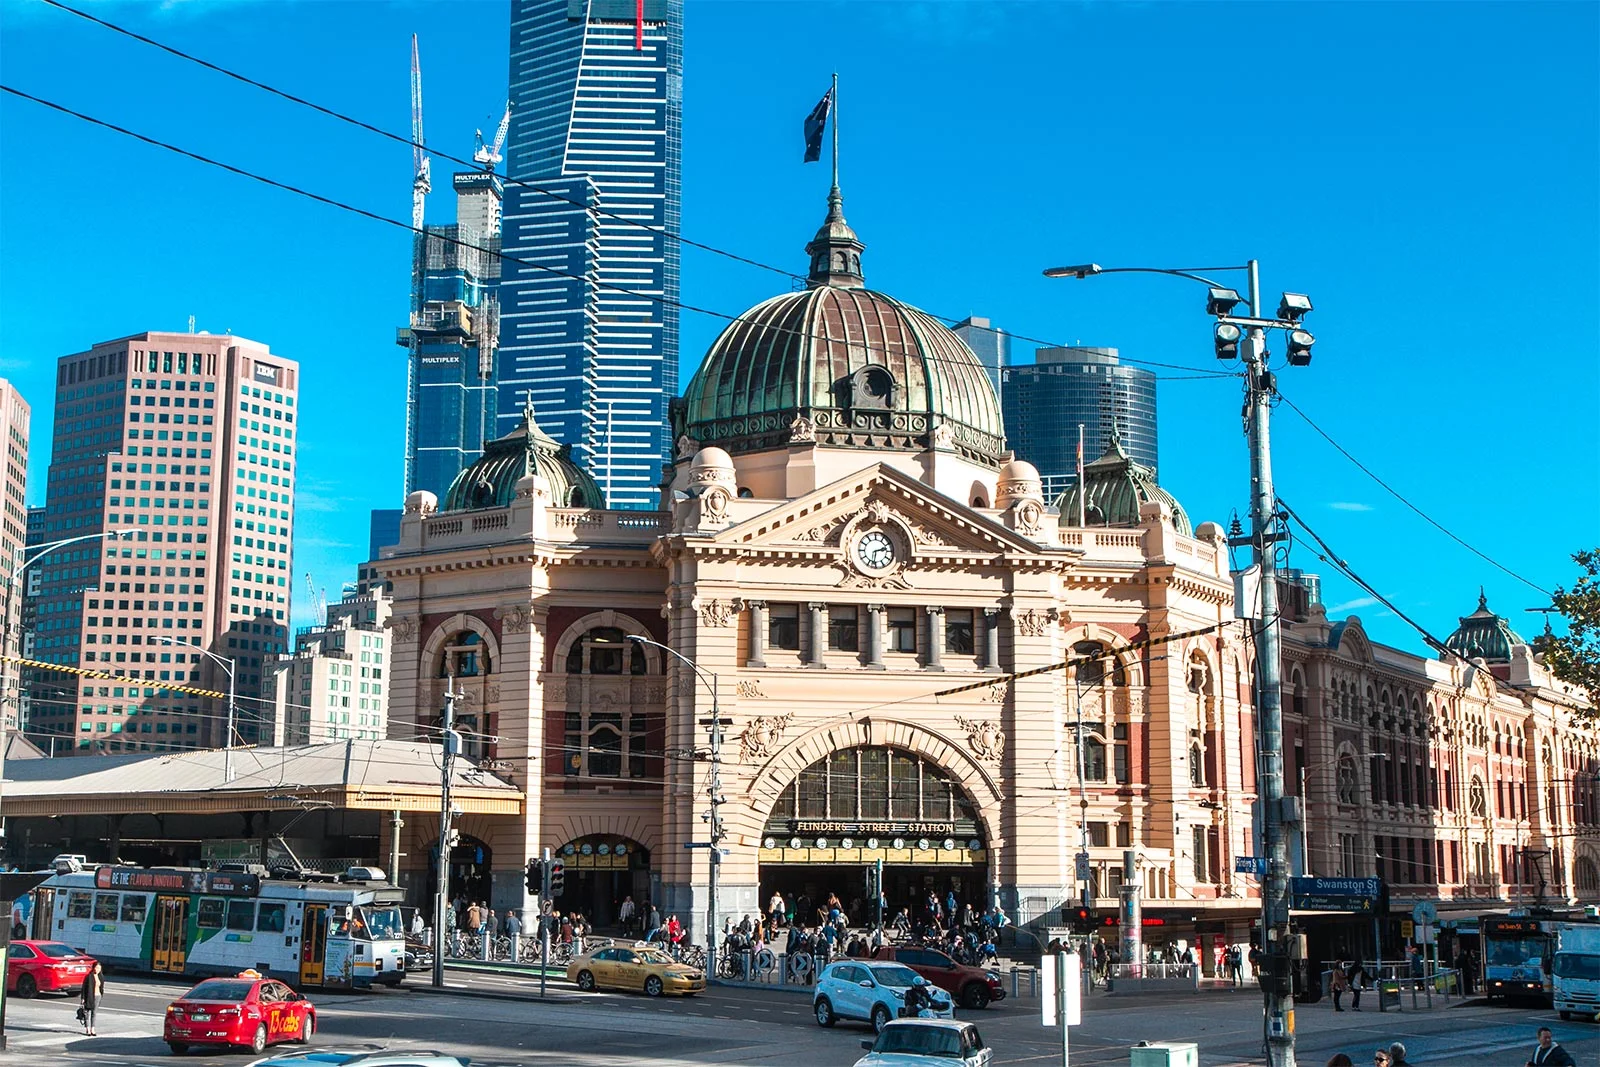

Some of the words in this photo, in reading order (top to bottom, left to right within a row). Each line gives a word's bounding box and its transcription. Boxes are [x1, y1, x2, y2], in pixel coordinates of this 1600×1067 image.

[256, 364, 275, 379] IBM
[797, 822, 848, 832] FLINDERS
[859, 822, 897, 832] STREET
[908, 823, 955, 833] STATION
[111, 872, 119, 885] BE
[120, 872, 130, 885] THE
[129, 873, 153, 886] FLAVOUR
[1316, 878, 1365, 889] Swanston
[1366, 879, 1377, 889] St
